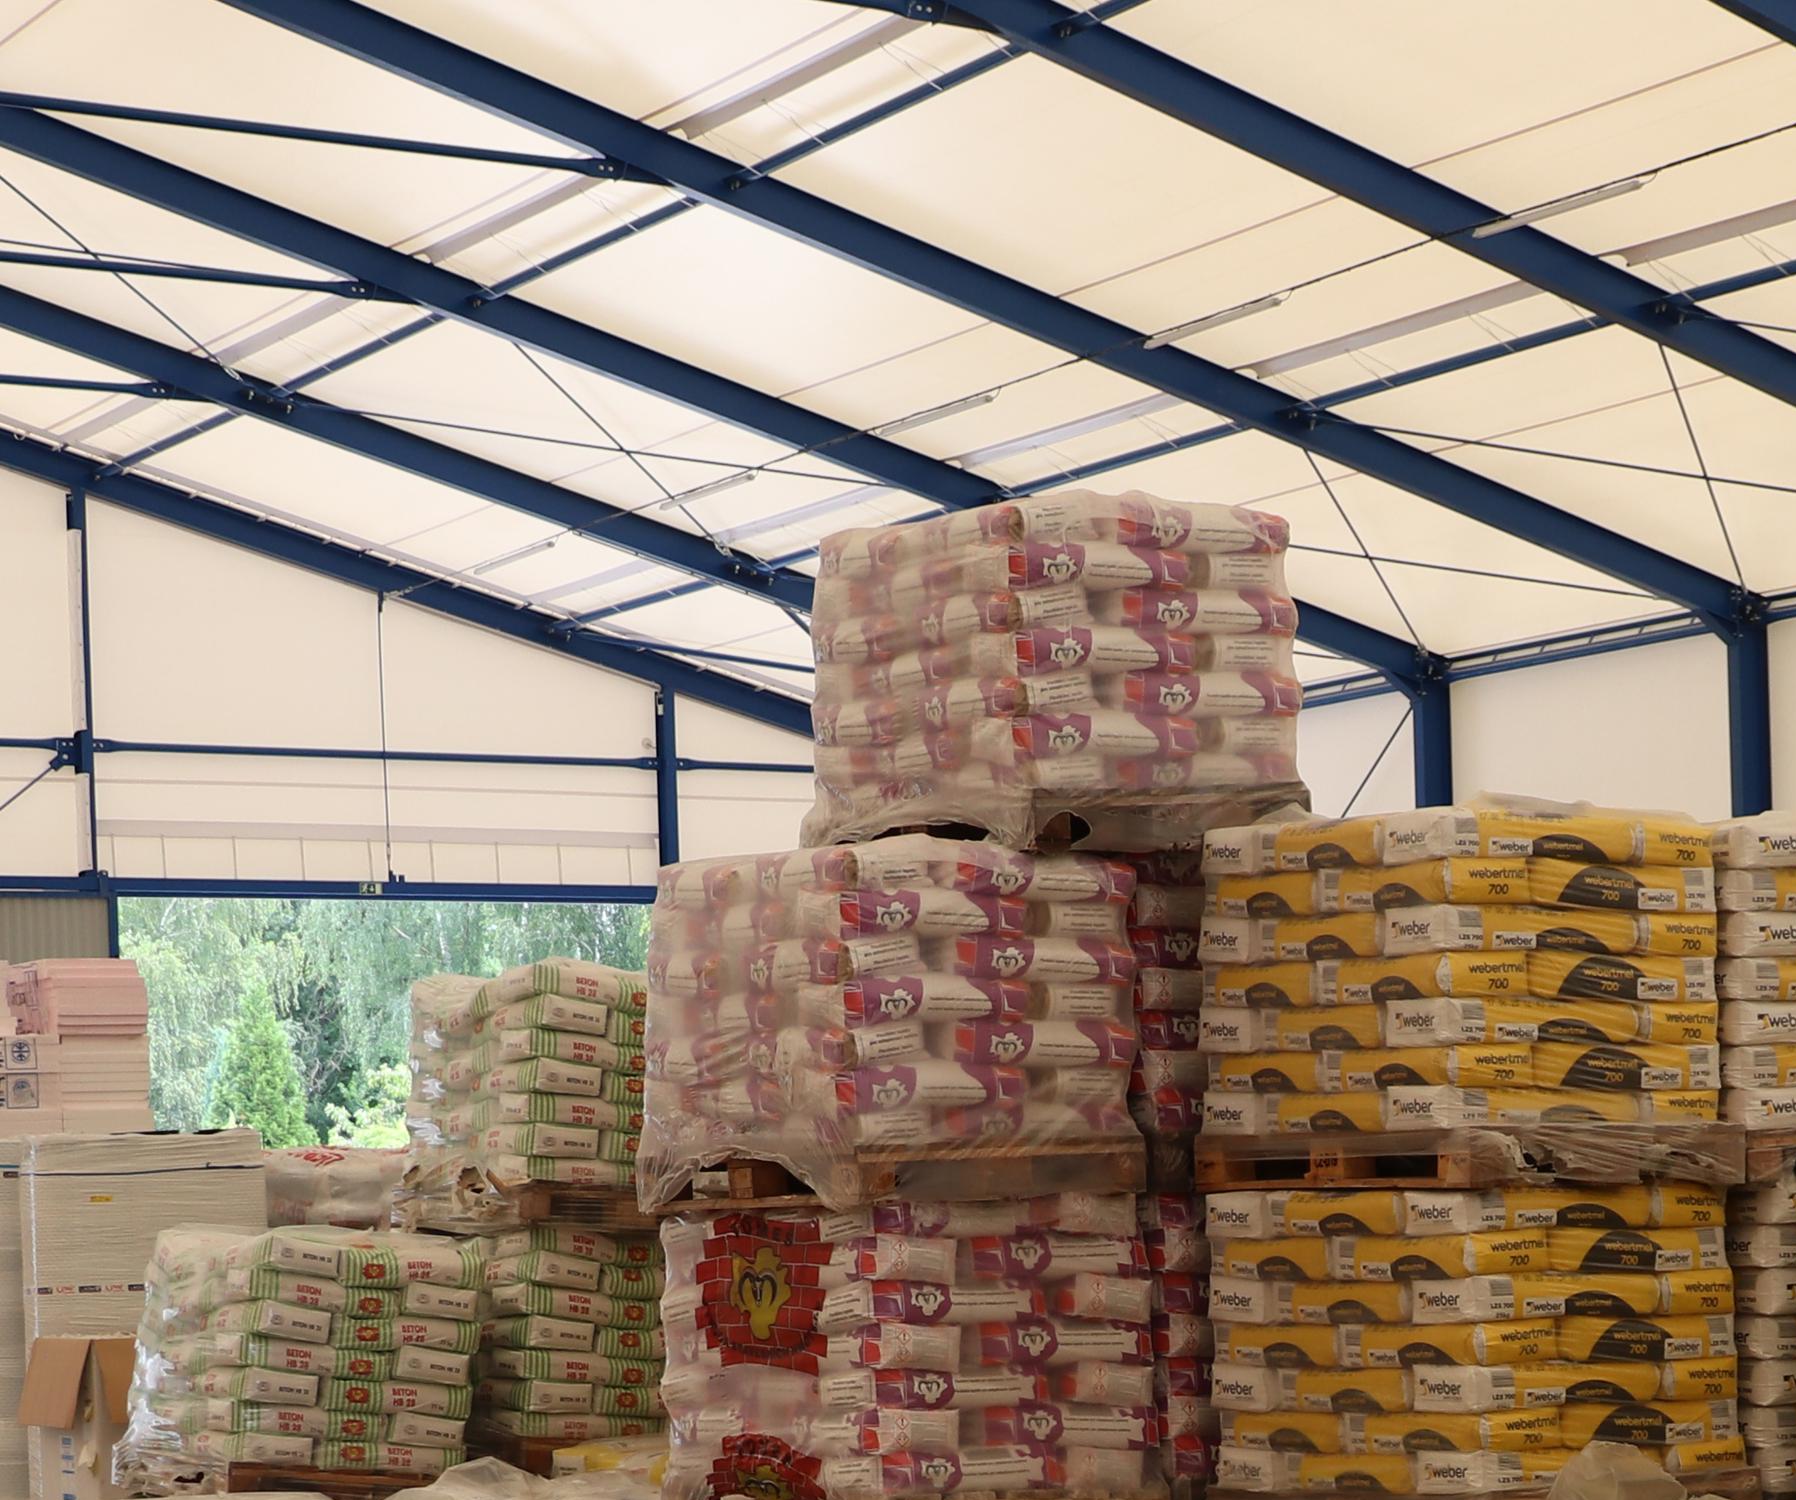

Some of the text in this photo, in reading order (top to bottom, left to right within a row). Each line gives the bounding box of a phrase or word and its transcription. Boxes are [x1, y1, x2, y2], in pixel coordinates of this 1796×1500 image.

[1212, 845, 1241, 859] weber
[1500, 841, 1529, 852] weber
[1488, 884, 1509, 894] 700
[1601, 890, 1620, 900] 700
[1400, 920, 1431, 937] weber
[1682, 939, 1701, 950] 700
[1488, 978, 1509, 989] 700
[573, 1042, 596, 1053] BETON
[1417, 1204, 1452, 1219] weber
[1426, 1293, 1460, 1308] weber
[392, 1388, 417, 1398] BETON
